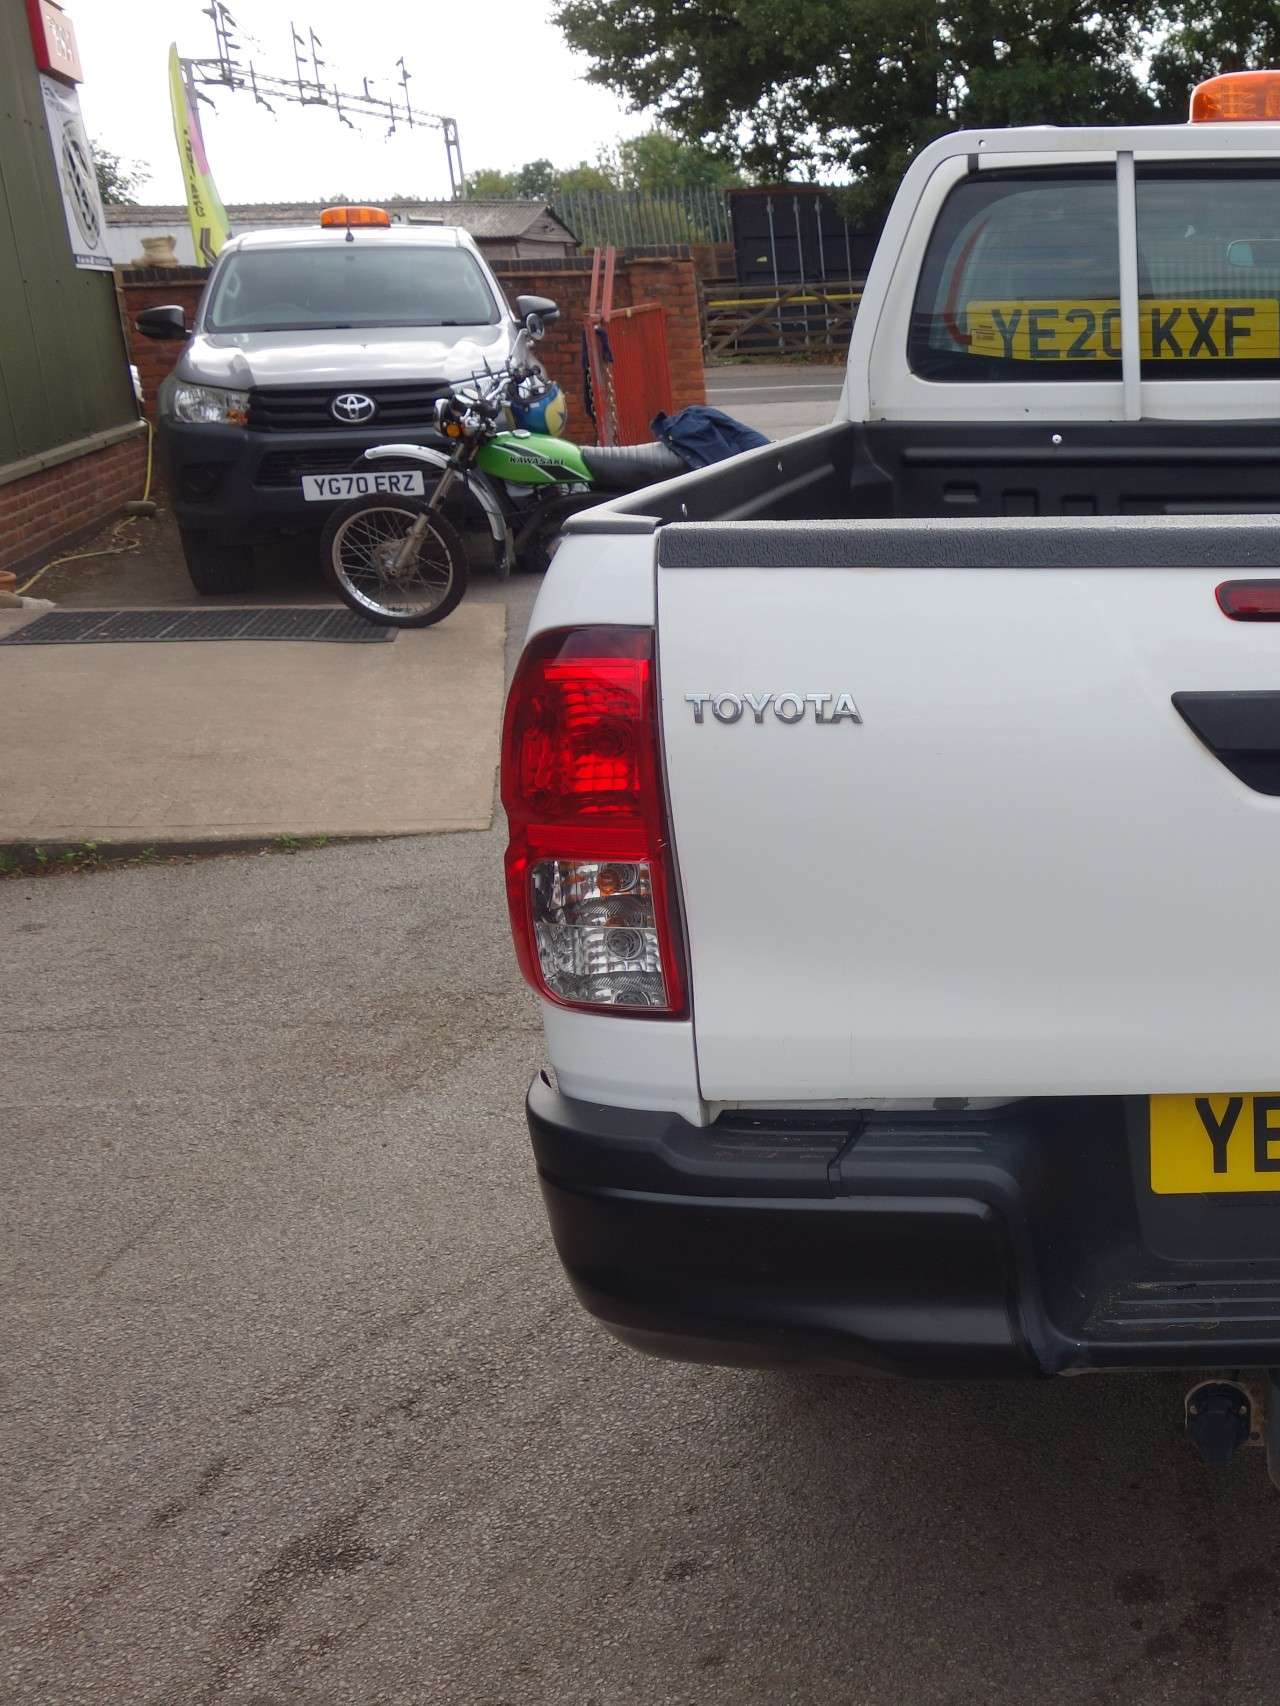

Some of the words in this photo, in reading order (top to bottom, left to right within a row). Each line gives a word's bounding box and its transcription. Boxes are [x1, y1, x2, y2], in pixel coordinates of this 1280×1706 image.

[1151, 307, 1255, 358] KXF
[509, 456, 565, 465] KAWASAKI
[314, 477, 368, 495] YG70
[374, 475, 414, 492] ERZ
[684, 692, 863, 724] TOYOTA
